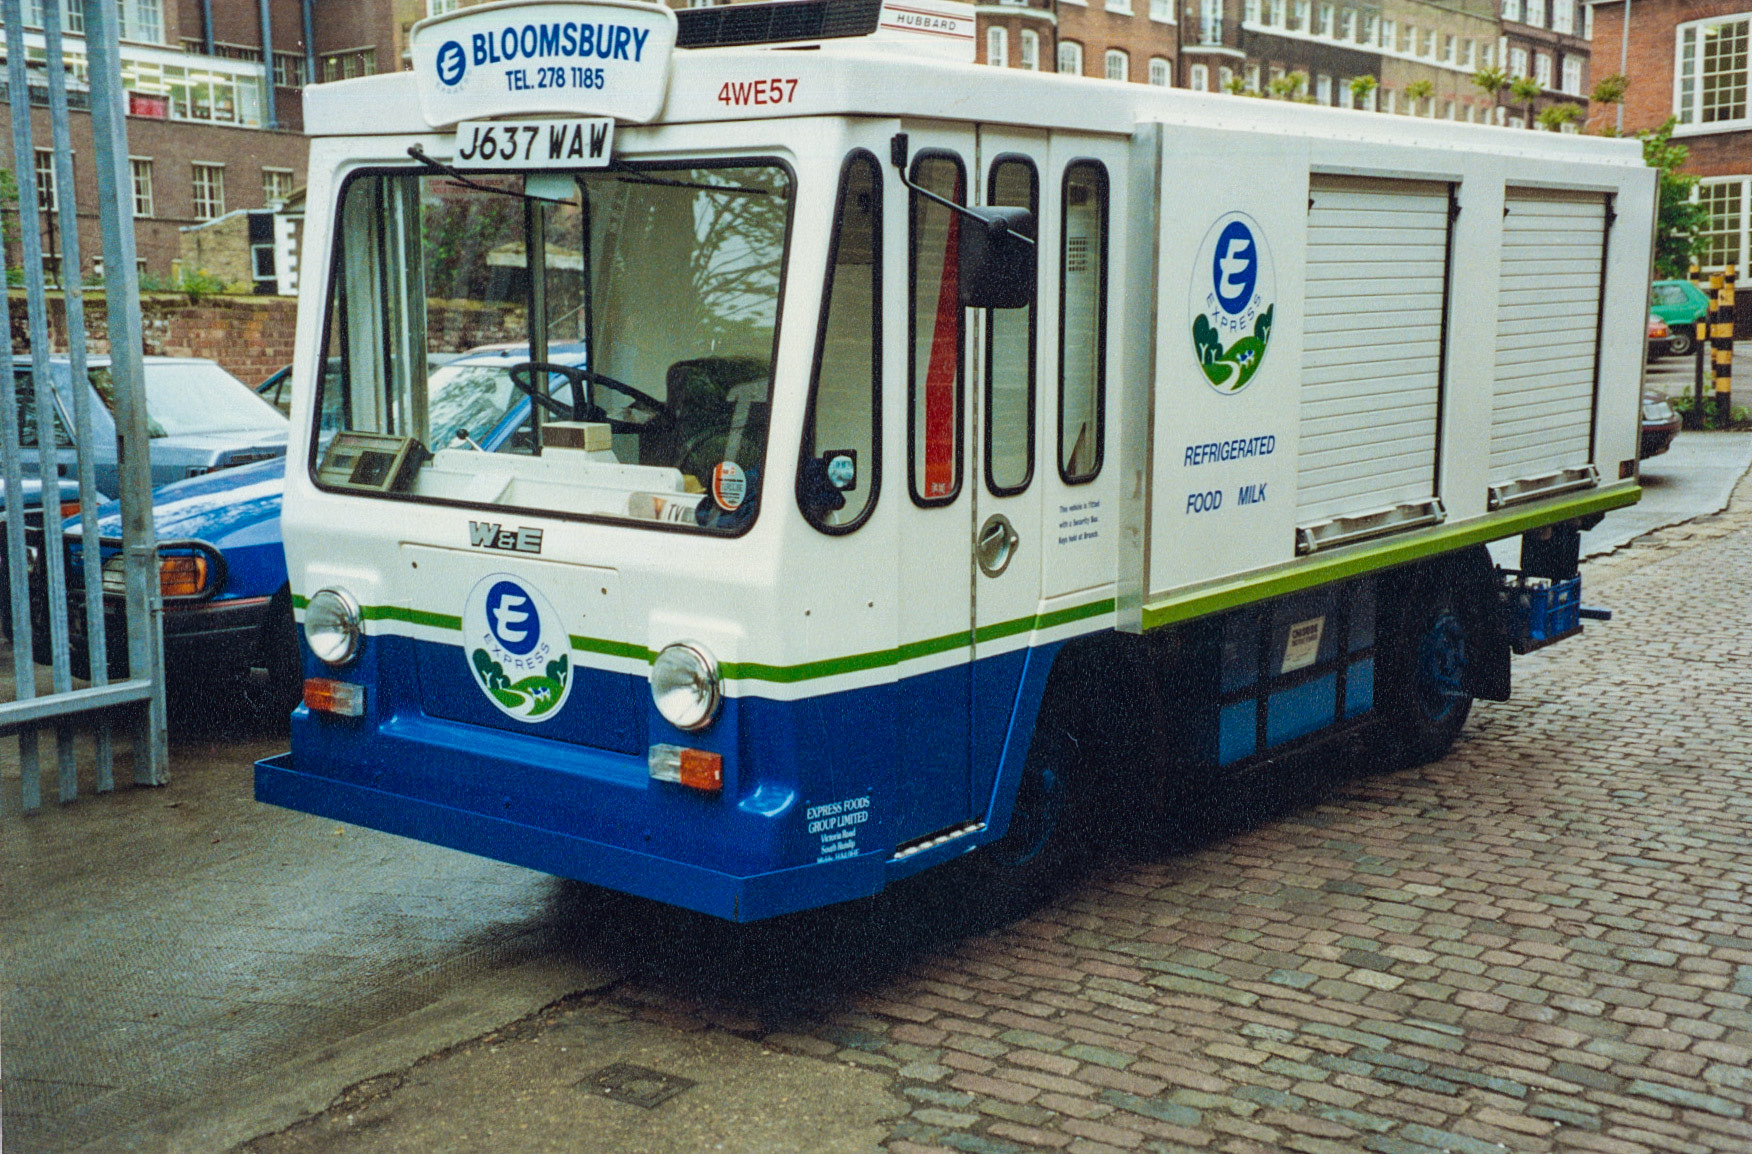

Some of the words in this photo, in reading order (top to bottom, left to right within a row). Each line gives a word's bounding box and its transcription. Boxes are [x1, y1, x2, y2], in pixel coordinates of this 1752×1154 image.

[897, 13, 957, 31] HUBBARD
[472, 22, 650, 67] BLOOMSBURY
[505, 69, 535, 91] TEL.
[537, 67, 566, 88] 278
[570, 67, 605, 90] 1185
[717, 78, 799, 106] 4WE57
[459, 126, 540, 161] J637
[549, 122, 609, 159] WAW
[1206, 291, 1262, 333] EXPRESS
[1183, 434, 1276, 467] REFRIGERATED
[1186, 489, 1223, 515] FOOD
[1237, 482, 1268, 506] MILK
[468, 521, 544, 554] W&E
[483, 631, 551, 672] EXPRESS
[807, 802, 842, 819] EXPRESS
[844, 796, 870, 811] FOODS
[808, 817, 837, 834] GROUP
[837, 811, 868, 827] LIMITED
